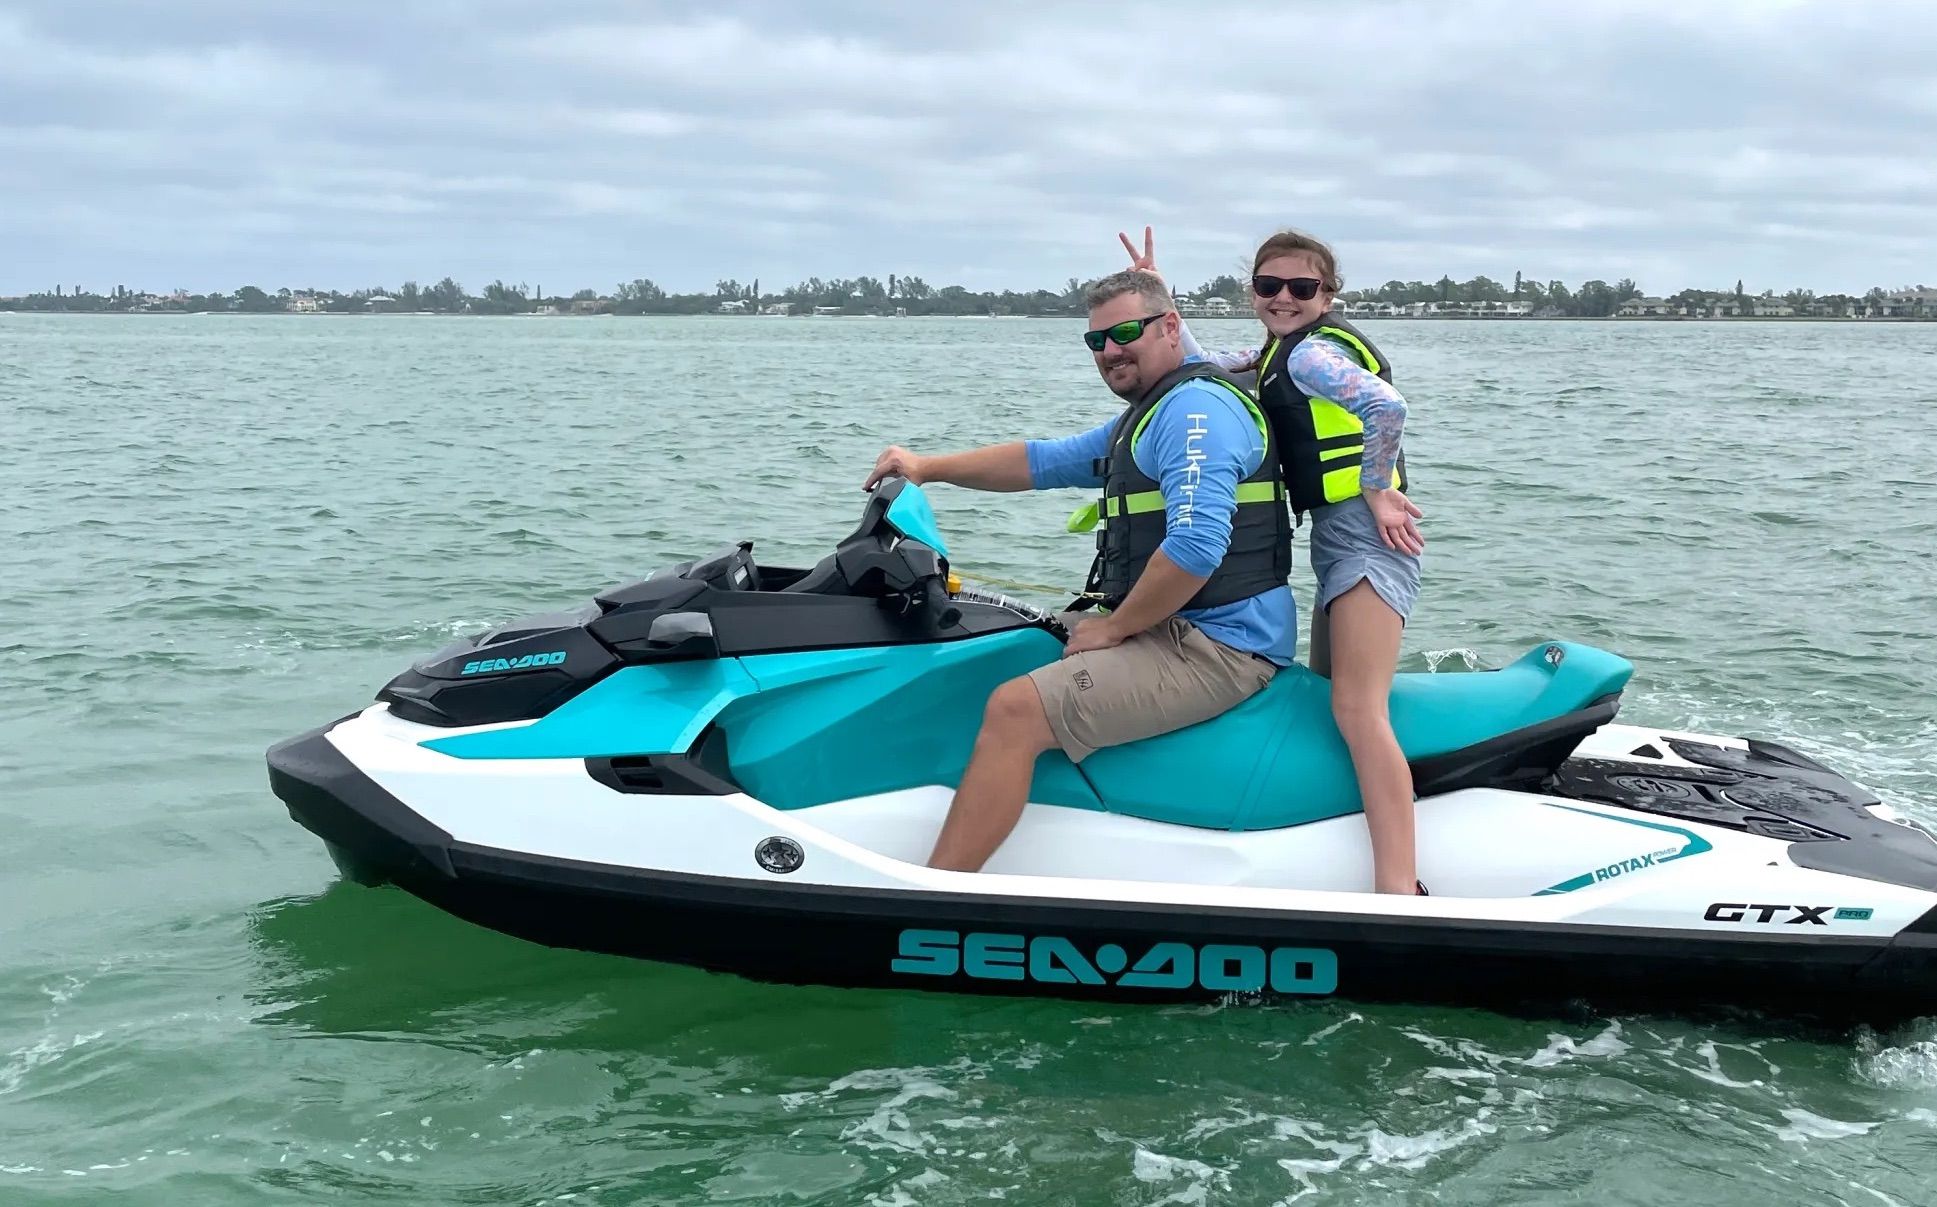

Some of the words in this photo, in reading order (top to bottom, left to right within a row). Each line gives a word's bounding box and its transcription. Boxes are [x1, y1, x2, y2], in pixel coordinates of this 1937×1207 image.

[1595, 853, 1655, 882] ROTAX
[1703, 902, 1834, 925] GTX
[1838, 909, 1869, 918] PRO
